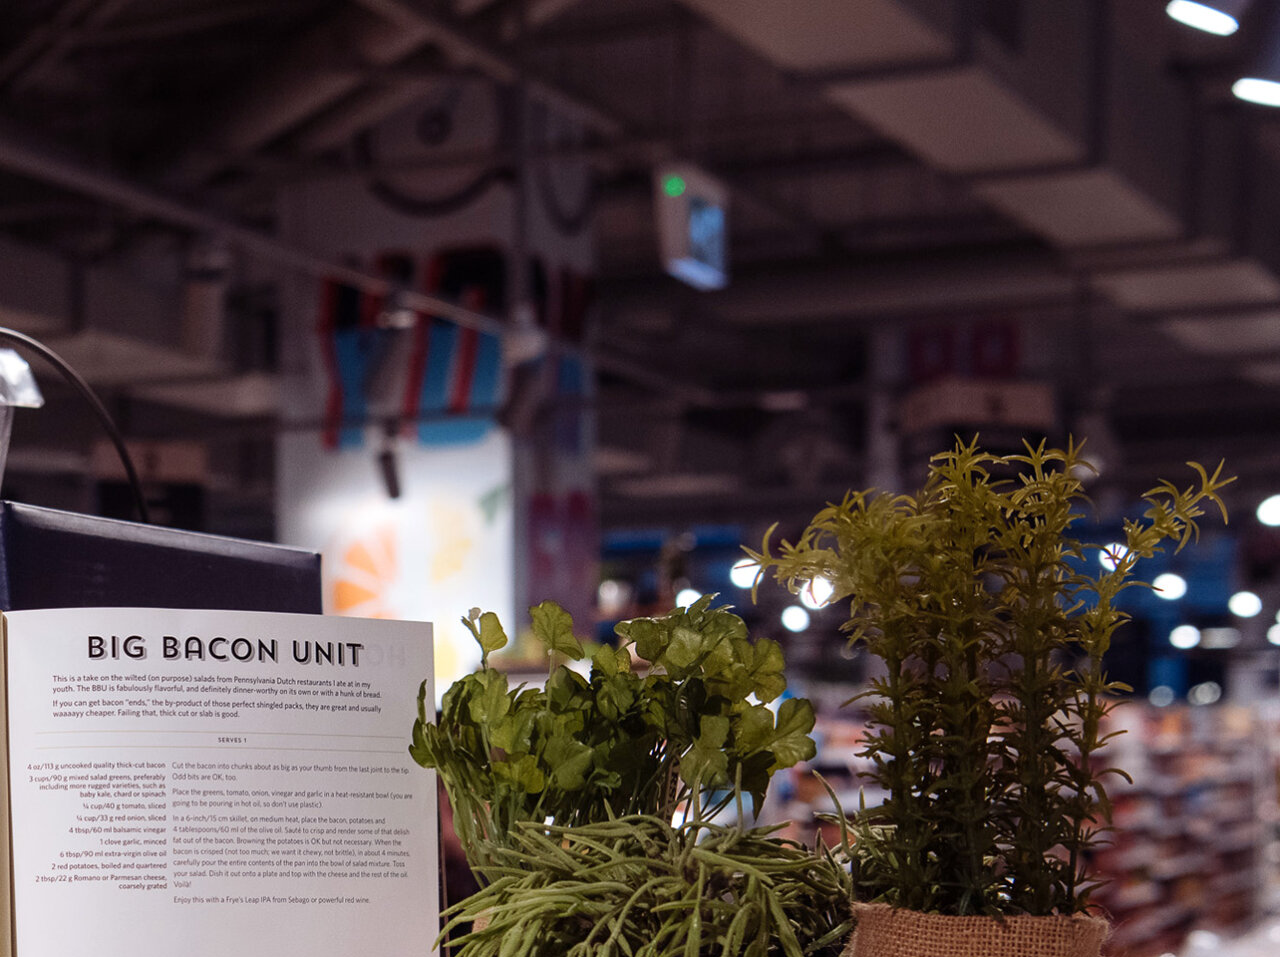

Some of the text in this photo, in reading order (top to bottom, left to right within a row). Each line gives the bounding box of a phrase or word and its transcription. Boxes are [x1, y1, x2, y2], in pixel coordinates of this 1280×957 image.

[87, 636, 145, 660] BIG
[162, 636, 278, 662] BACON
[292, 640, 363, 666] UNIT
[147, 674, 159, 683] (on
[161, 675, 192, 684] purpose)
[233, 675, 275, 685] Pennsylvania
[52, 685, 74, 694] youth.
[116, 684, 152, 694] fabulously
[200, 685, 230, 694] definitely
[232, 686, 278, 695] dinner-worthy
[88, 699, 100, 708] get
[164, 699, 202, 708] by-product
[231, 700, 255, 709] perfect
[256, 701, 282, 710] shingled
[284, 702, 303, 711] packs,
[305, 702, 318, 712] they
[331, 704, 347, 712] great
[360, 705, 381, 714] usually
[85, 709, 116, 718] cheaper.
[117, 709, 140, 718] Failing
[221, 710, 239, 719] good.
